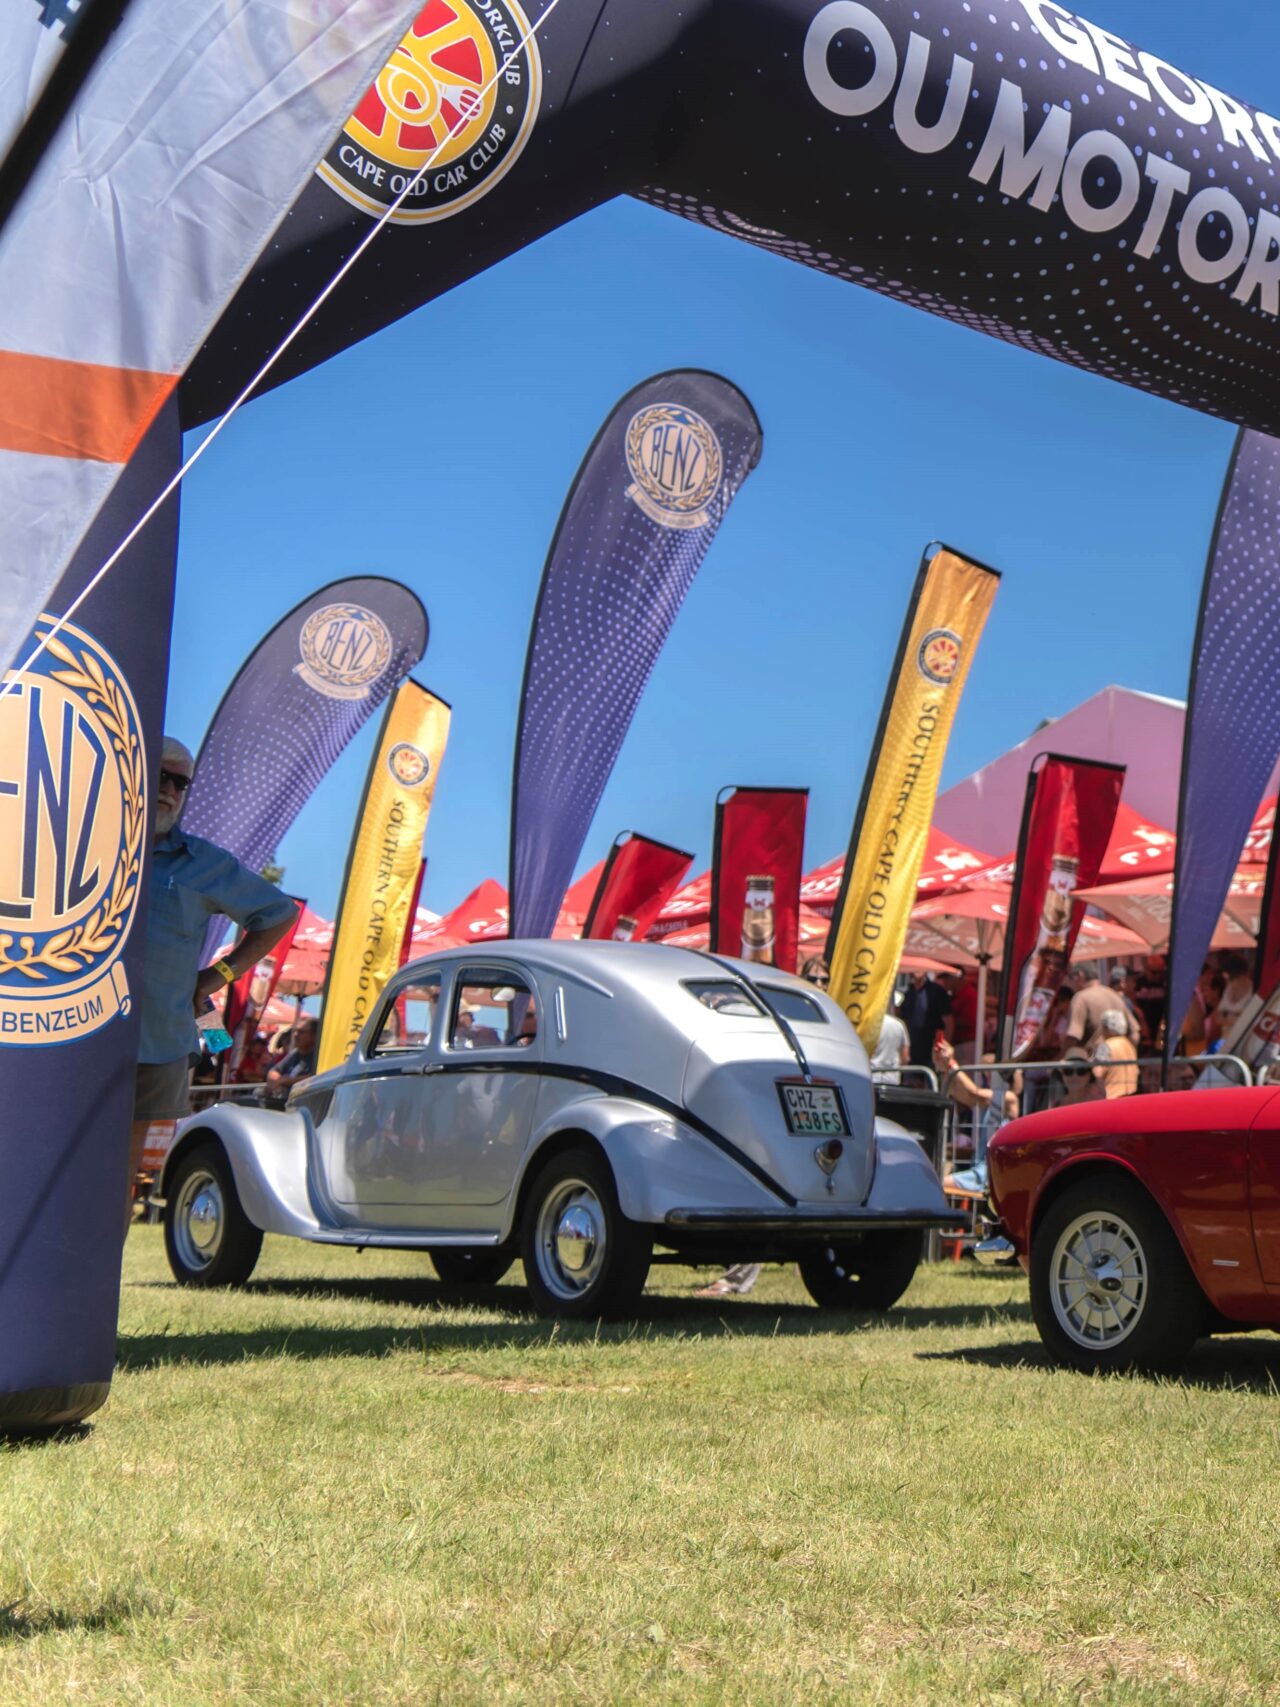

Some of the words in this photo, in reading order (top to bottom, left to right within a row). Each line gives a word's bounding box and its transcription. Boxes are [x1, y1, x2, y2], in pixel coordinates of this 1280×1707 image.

[802, 0, 974, 154] OU
[338, 145, 386, 188] CAPE
[389, 174, 429, 197] OLD
[433, 164, 469, 193] CAR
[469, 122, 507, 172] CLUB
[649, 421, 703, 493] BENZ
[320, 620, 375, 673] BENZ
[374, 798, 404, 893] SOUTHERN
[873, 828, 900, 885] CAPE
[366, 899, 388, 946] CAPE
[860, 891, 886, 940] OLD
[357, 950, 375, 990] OLD
[848, 948, 875, 996] CAR
[1, 996, 105, 1036] BENZEUM
[350, 997, 367, 1033] CAR
[786, 1088, 817, 1110] CHZ
[792, 1110, 843, 1133] 138FS
